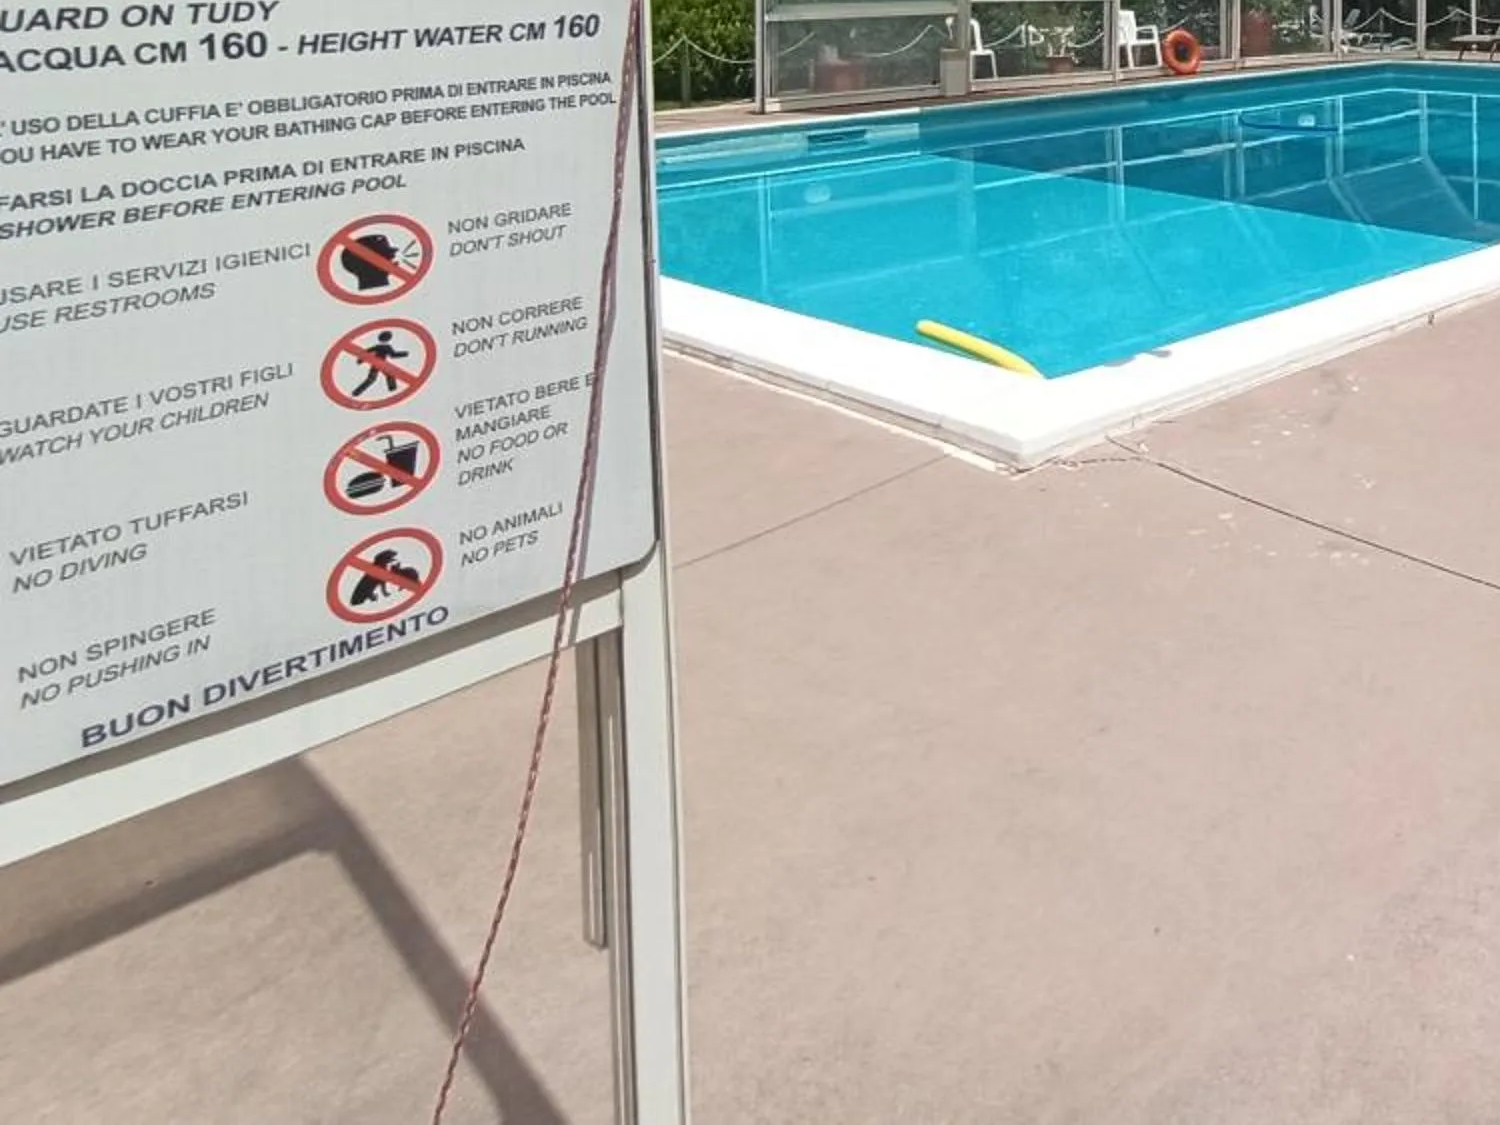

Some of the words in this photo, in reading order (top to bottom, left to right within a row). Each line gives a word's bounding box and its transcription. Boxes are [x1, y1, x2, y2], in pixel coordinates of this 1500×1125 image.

[0, 6, 108, 33] UARD
[121, 4, 174, 27] ON
[187, 0, 280, 25] TUDY
[133, 41, 187, 65] CM
[199, 31, 268, 61] 160
[298, 29, 407, 55] HEIGHT
[413, 24, 502, 48] WATER
[509, 22, 545, 42] CM
[553, 14, 600, 39] 160
[11, 116, 61, 136] USO
[67, 110, 140, 131] DELLA
[144, 104, 221, 124] CUFFIA
[247, 91, 387, 115] OBBLIGATORIO
[391, 85, 444, 102] PRIMA
[447, 84, 463, 98] DI
[467, 76, 537, 96] ENTRARE
[540, 75, 554, 89] IN
[557, 72, 611, 88] PISCINA
[40, 140, 101, 161] HAVE
[107, 137, 136, 154] TO
[142, 131, 206, 150] WEAR
[213, 124, 269, 143] YOUR
[274, 112, 357, 137] BATHING
[360, 113, 396, 129] CAP
[401, 106, 466, 125] BEFORE
[471, 97, 545, 118] ENTERING
[549, 95, 576, 109] THE
[579, 92, 616, 106] POOL
[81, 184, 114, 203] LA
[121, 173, 217, 198] DOCCIA
[224, 162, 296, 185] PRIMA
[302, 160, 324, 176] DI
[331, 148, 425, 173] ENTRARE
[431, 146, 449, 161] IN
[454, 138, 525, 158] PISCINA
[0, 210, 115, 239] SHOWER
[123, 196, 224, 224] BEFORE
[231, 181, 345, 210] ENTERING
[351, 175, 407, 194] POOL
[448, 216, 488, 235] NON
[494, 202, 572, 227] GRIDARE
[450, 235, 504, 257] DON'T
[508, 224, 567, 247] SHOUT
[93, 275, 99, 290] I
[108, 260, 207, 288] SERVIZI
[215, 243, 311, 271] IGIENICI
[54, 283, 216, 324] RESTROOMS
[451, 315, 493, 335] NON
[499, 296, 583, 325] CORRERE
[453, 334, 510, 358] DON'T
[512, 316, 588, 346] RUNNING
[136, 394, 142, 409] I
[149, 375, 233, 406] VOSTRI
[240, 363, 293, 387] FIGLI
[454, 390, 530, 419] VIETATO
[535, 376, 580, 399] BERE
[90, 417, 155, 444] YOUR
[160, 392, 270, 429] CHILDREN
[455, 404, 552, 441] MANGIARE
[457, 444, 485, 463] NO
[489, 430, 539, 455] FOOD
[543, 422, 569, 440] OR
[457, 457, 514, 486] DRINK
[9, 524, 122, 566] VIETATO
[128, 491, 248, 535] TUFFARSI
[459, 525, 487, 545] NO
[492, 501, 563, 535] ANIMALI
[12, 568, 53, 594] NO
[59, 542, 148, 581] DIVING
[461, 546, 489, 567] NO
[493, 530, 539, 557] PETS
[18, 650, 77, 683] NON
[86, 607, 217, 661] SPINGERE
[20, 682, 60, 710] NO
[67, 644, 181, 695] PUSHING
[187, 634, 211, 656] IN
[81, 693, 191, 748] BUON
[203, 606, 449, 707] DIVERTIMENTO
